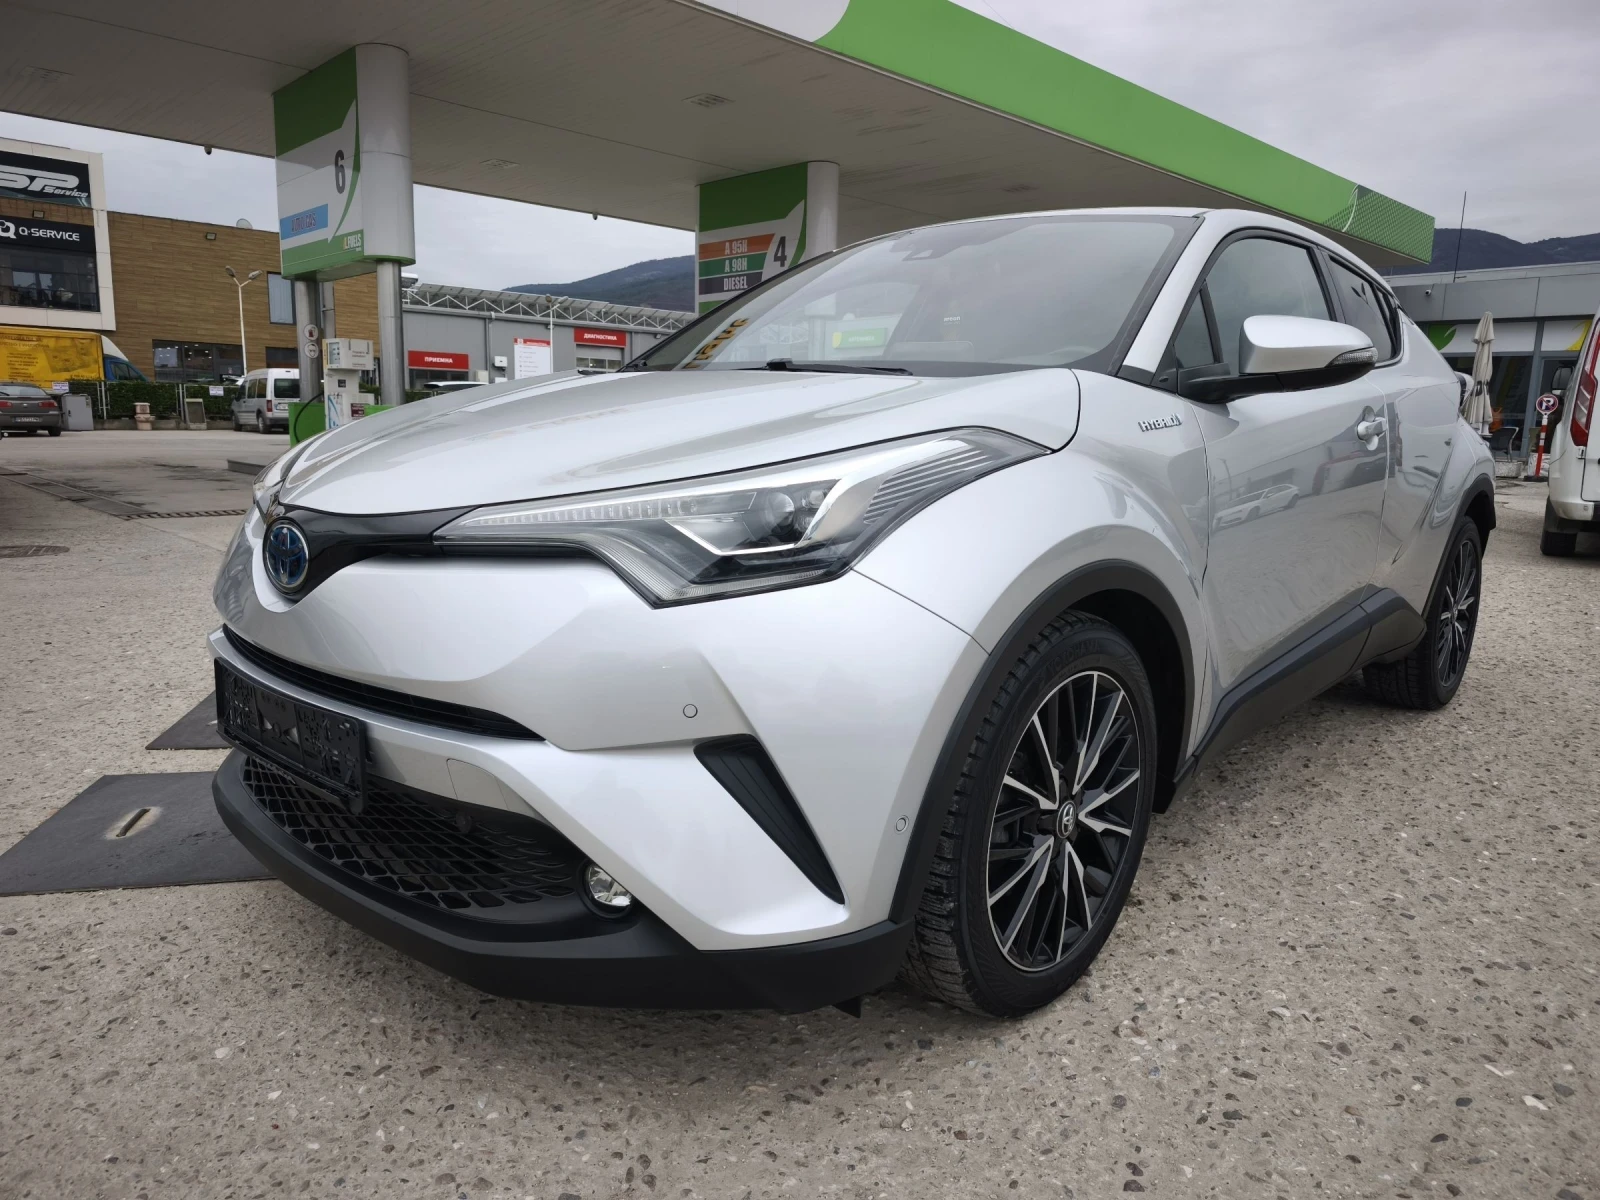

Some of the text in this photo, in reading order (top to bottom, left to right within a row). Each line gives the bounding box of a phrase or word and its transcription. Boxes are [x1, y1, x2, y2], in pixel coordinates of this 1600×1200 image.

[334, 149, 346, 194] 6
[44, 187, 88, 198] Service
[773, 235, 788, 268] 4
[723, 275, 748, 291] DIESEL
[583, 332, 618, 341] ДИАГНОСТИКА
[424, 356, 454, 364] ПРИЕМНА
[1138, 415, 1178, 432] HYBRID
